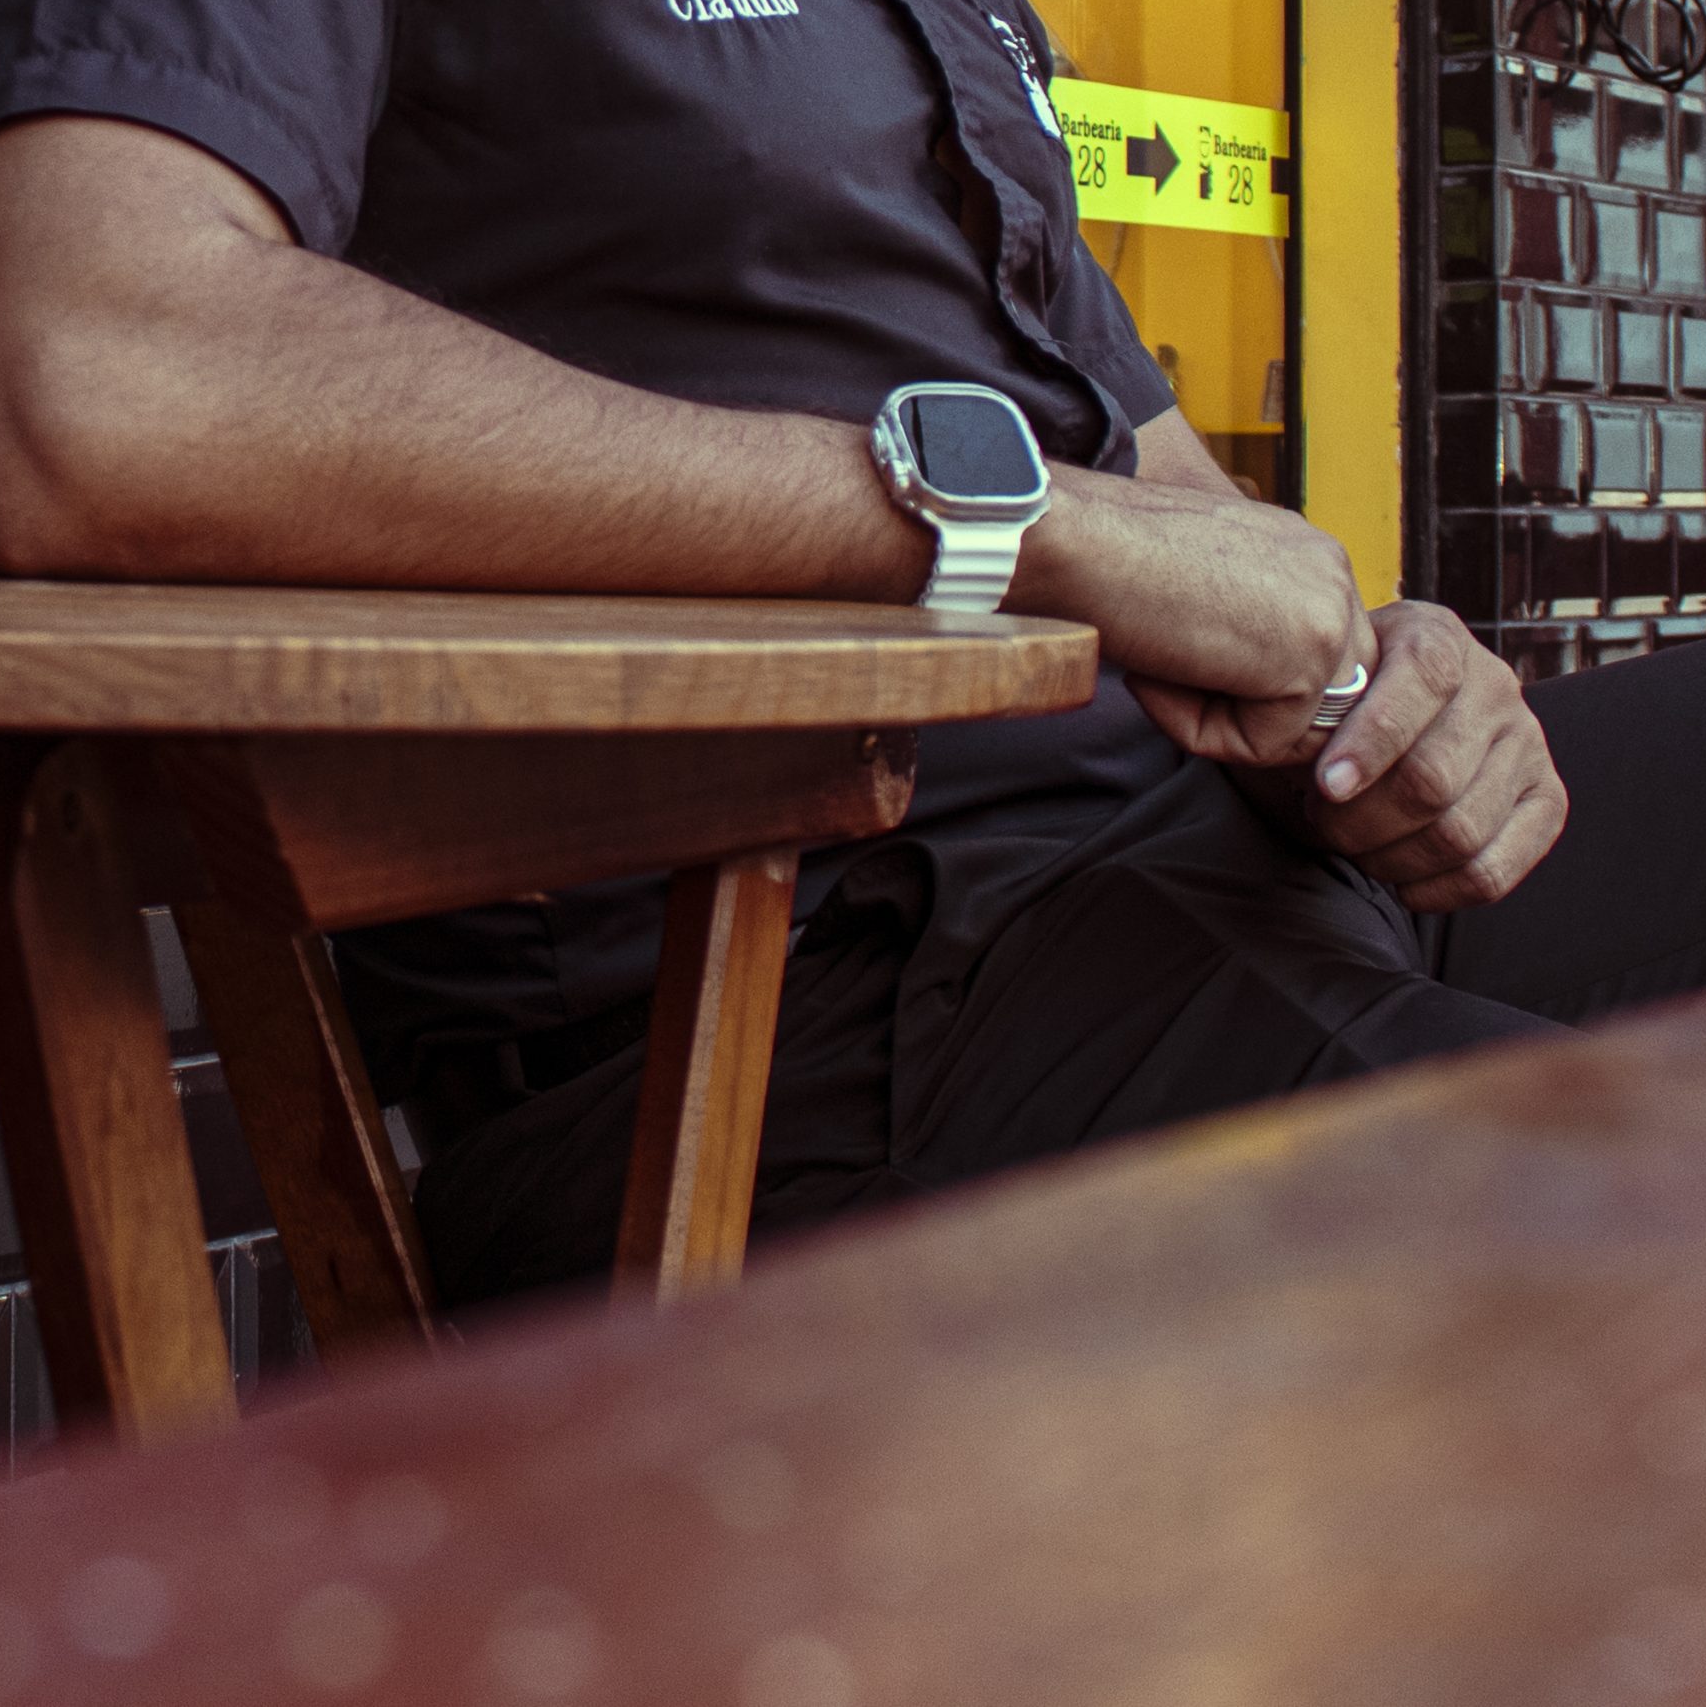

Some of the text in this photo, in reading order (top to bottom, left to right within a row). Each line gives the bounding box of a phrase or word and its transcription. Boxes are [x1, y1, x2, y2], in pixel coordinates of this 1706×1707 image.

[1060, 112, 1122, 141] Barbearia
[1214, 134, 1267, 161] Barbearia
[1077, 145, 1106, 188] 28
[1228, 165, 1254, 205] 28
